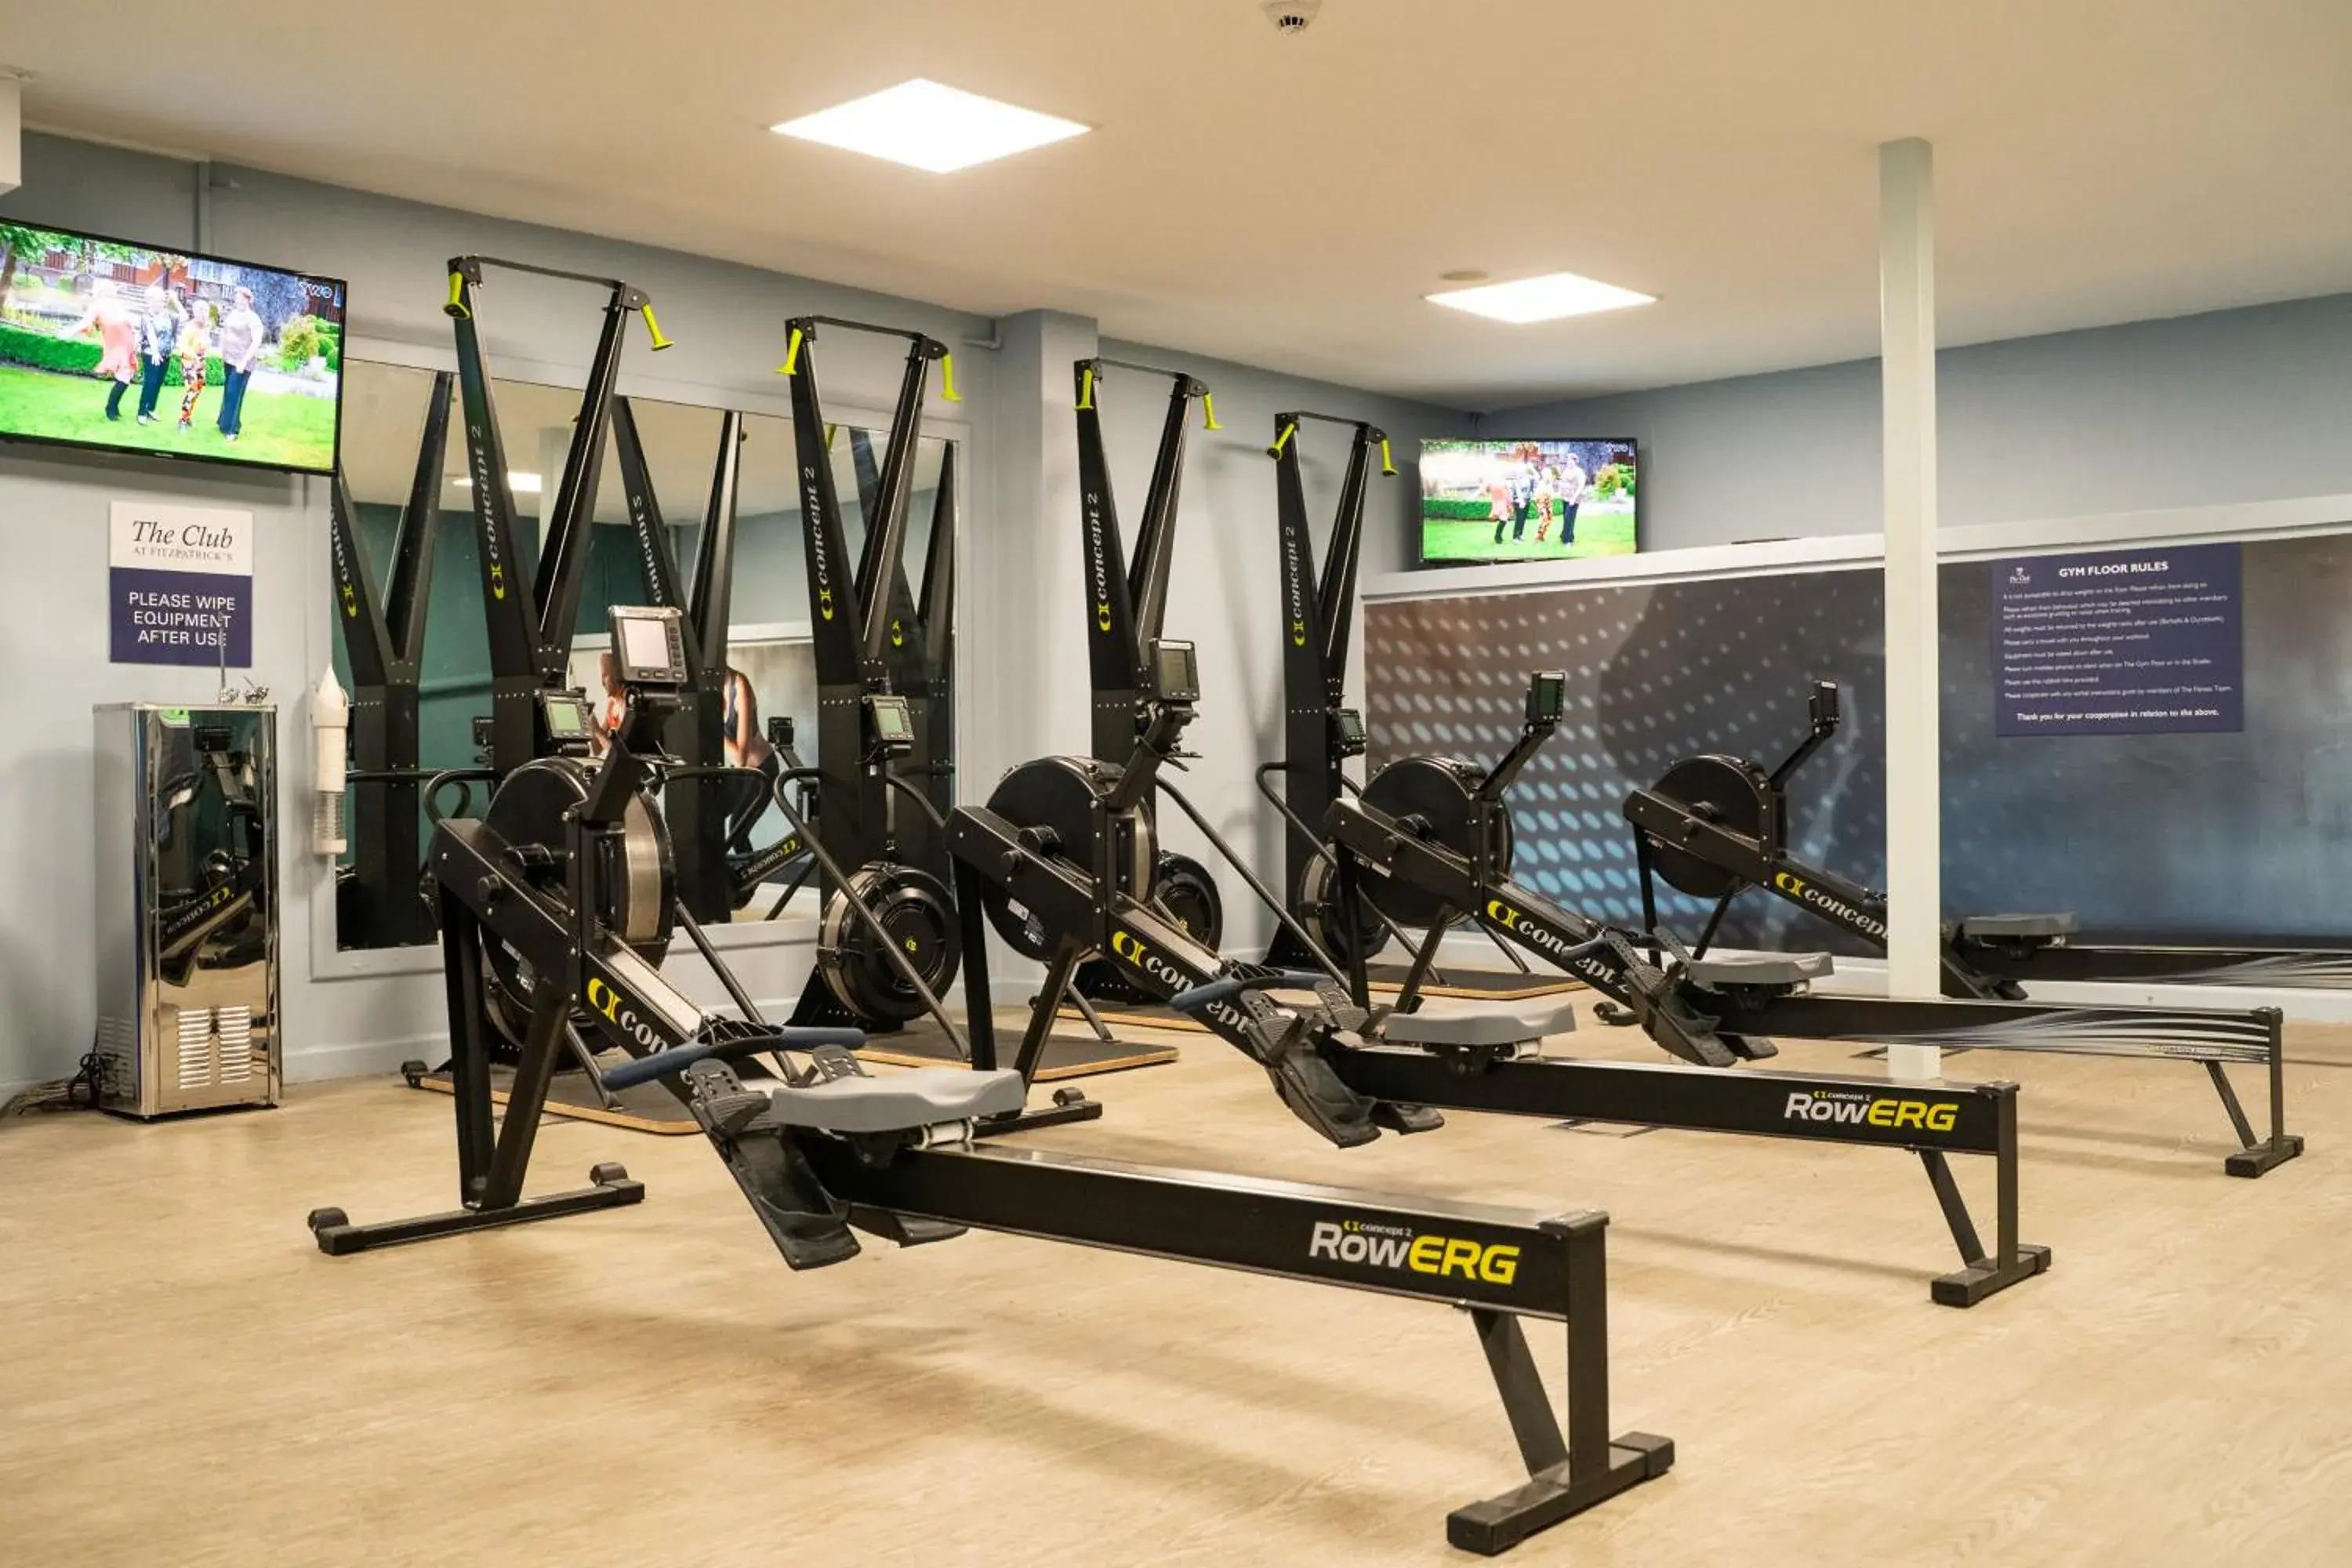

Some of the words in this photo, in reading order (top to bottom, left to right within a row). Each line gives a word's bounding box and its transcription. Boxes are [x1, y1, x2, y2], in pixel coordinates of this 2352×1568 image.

[471, 426, 481, 438] 2
[804, 466, 815, 479] 2
[475, 446, 499, 560] concept
[1088, 492, 1098, 504] 2
[132, 520, 175, 545] The
[182, 524, 233, 550] Club
[808, 485, 829, 584] concept
[1285, 526, 1294, 535] 2
[132, 546, 147, 556] AT
[1089, 508, 1107, 600] concept
[2059, 566, 2085, 577] GYM
[2088, 564, 2129, 575] FLOOR
[2130, 561, 2169, 572] RULES
[1287, 542, 1302, 619] concept
[129, 592, 191, 608] PLEASE
[196, 596, 236, 612] WIPE
[134, 611, 231, 628] EQUIPMENT
[137, 630, 190, 644] AFTER
[2016, 712, 2038, 720] Thank
[2140, 709, 2167, 718] relation
[2180, 708, 2192, 717] the
[2194, 708, 2220, 717] above.
[1145, 956, 1249, 1034] conept
[1359, 1222, 1404, 1236] concept
[1406, 1228, 1412, 1237] 2
